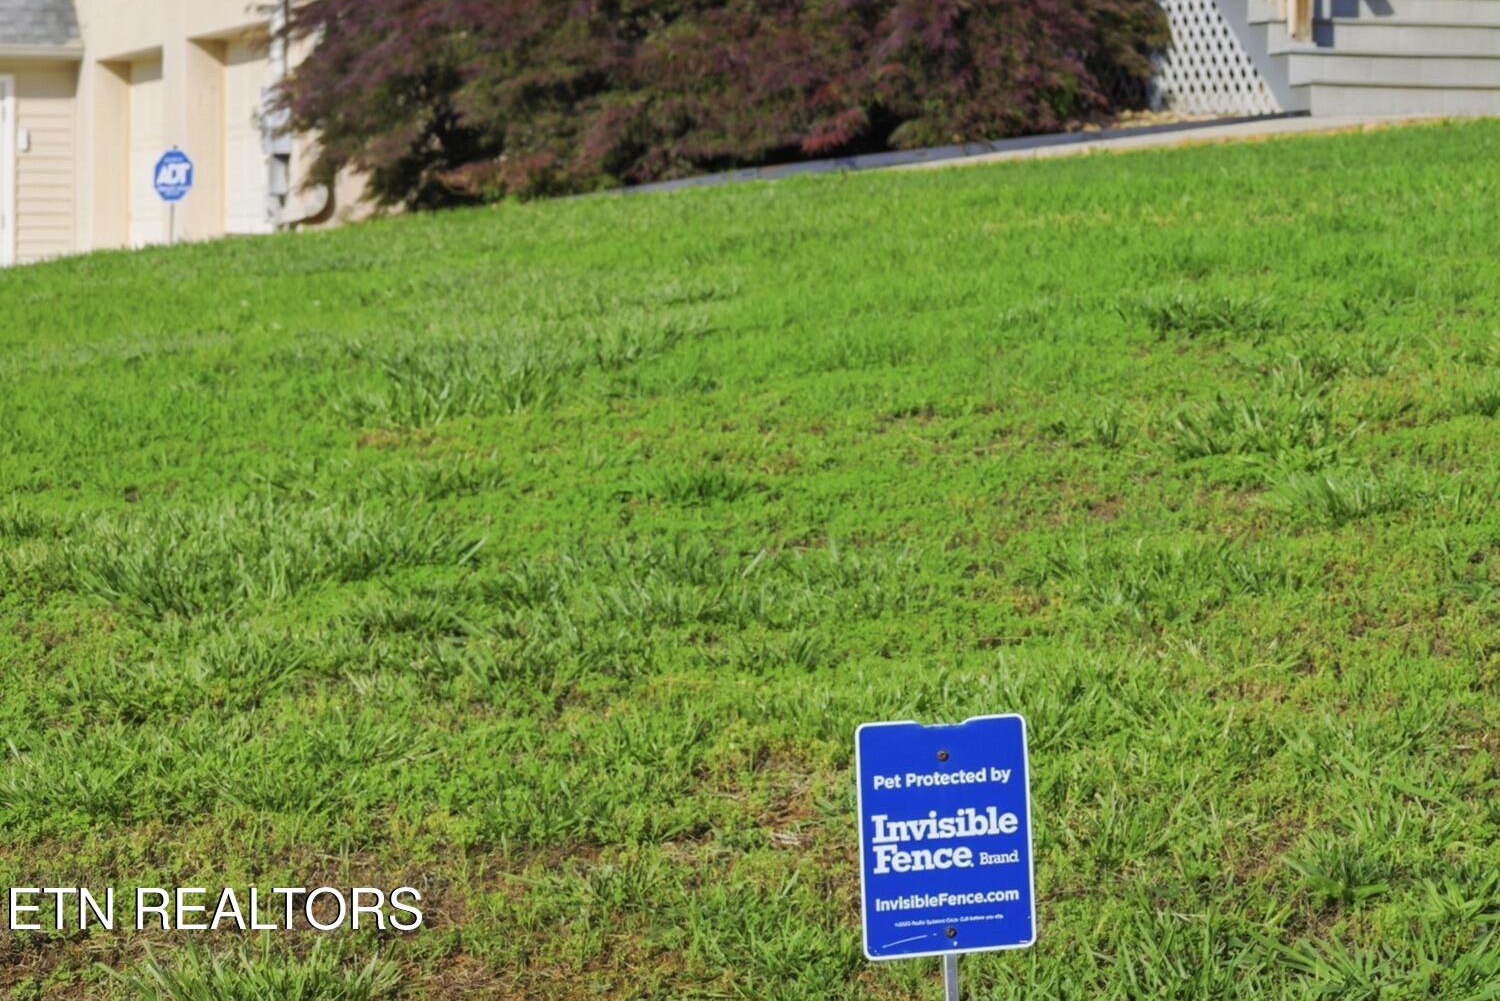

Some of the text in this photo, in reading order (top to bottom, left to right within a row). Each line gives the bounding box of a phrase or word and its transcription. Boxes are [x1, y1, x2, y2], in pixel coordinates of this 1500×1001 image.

[873, 766, 1012, 790] Pet Protected by
[871, 806, 1019, 844] Invisible
[979, 849, 1020, 866] Brand
[875, 889, 1020, 912] InvisibleFence.com
